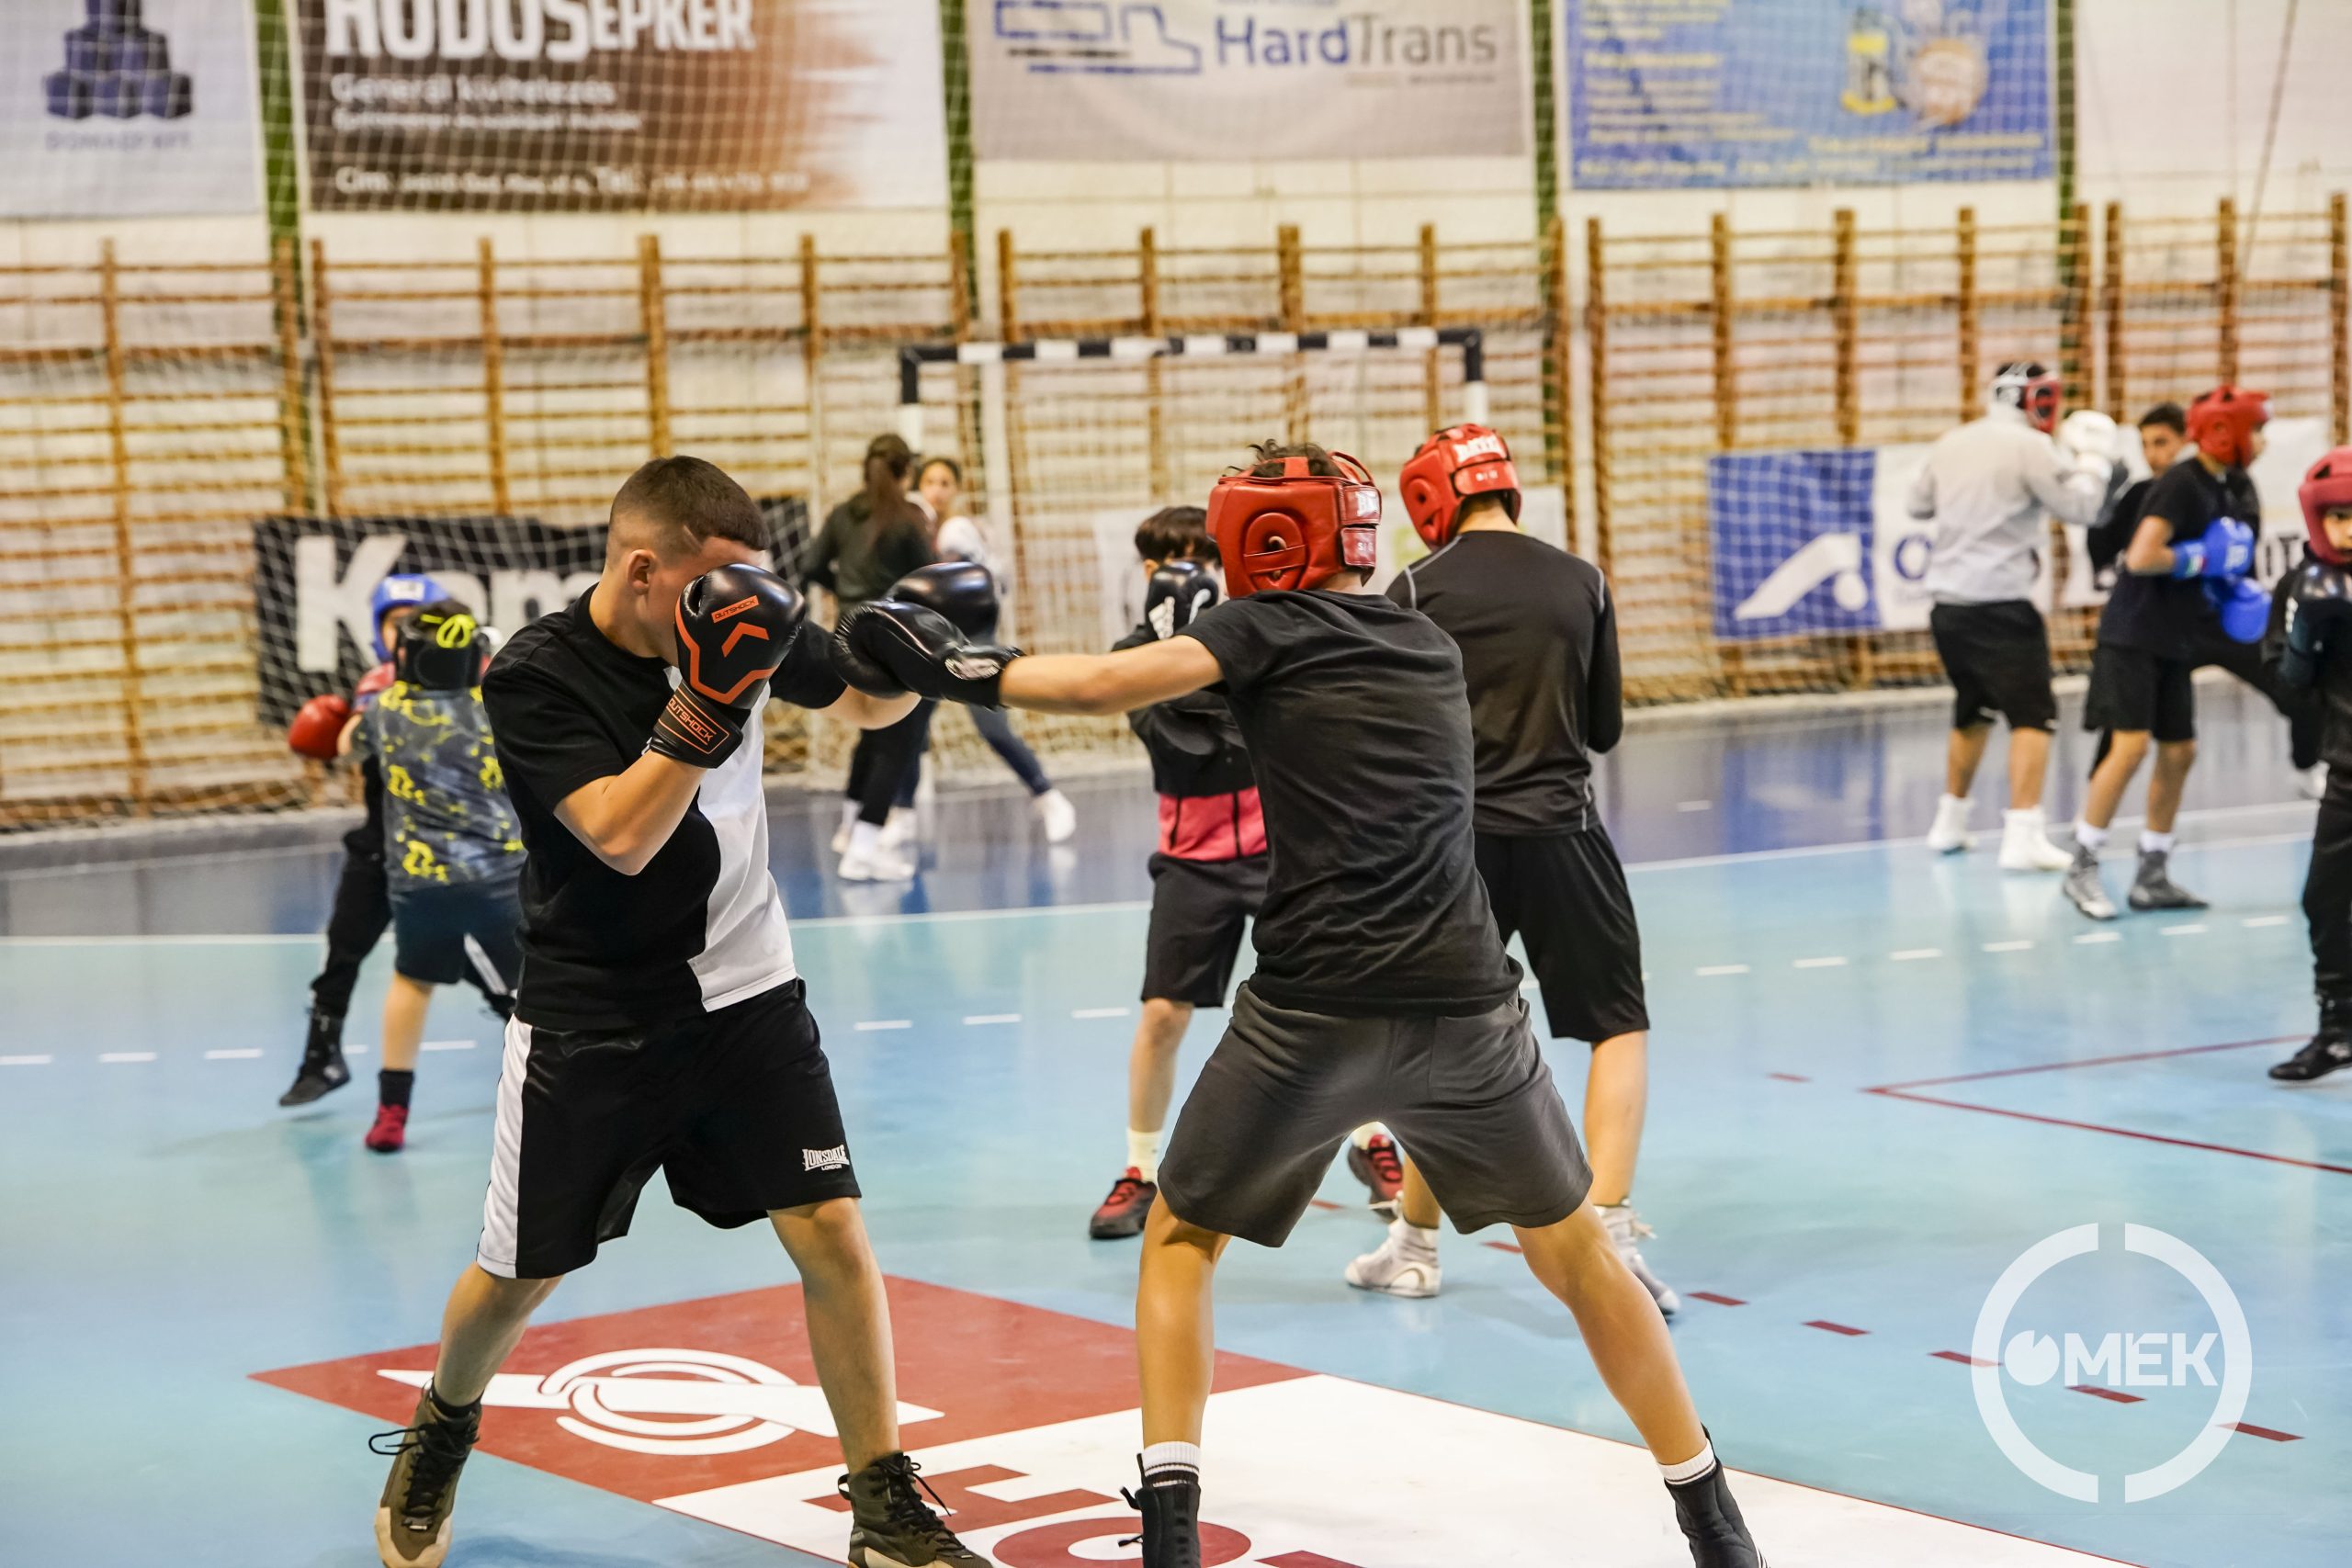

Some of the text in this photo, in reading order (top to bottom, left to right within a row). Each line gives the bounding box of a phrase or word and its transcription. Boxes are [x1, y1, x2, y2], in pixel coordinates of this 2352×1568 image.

[1216, 13, 1498, 64] HardTrans
[714, 598, 756, 619] OUTSHOCK
[667, 697, 714, 742] OUTSHOCK
[802, 1145, 848, 1171] LONSDALE
